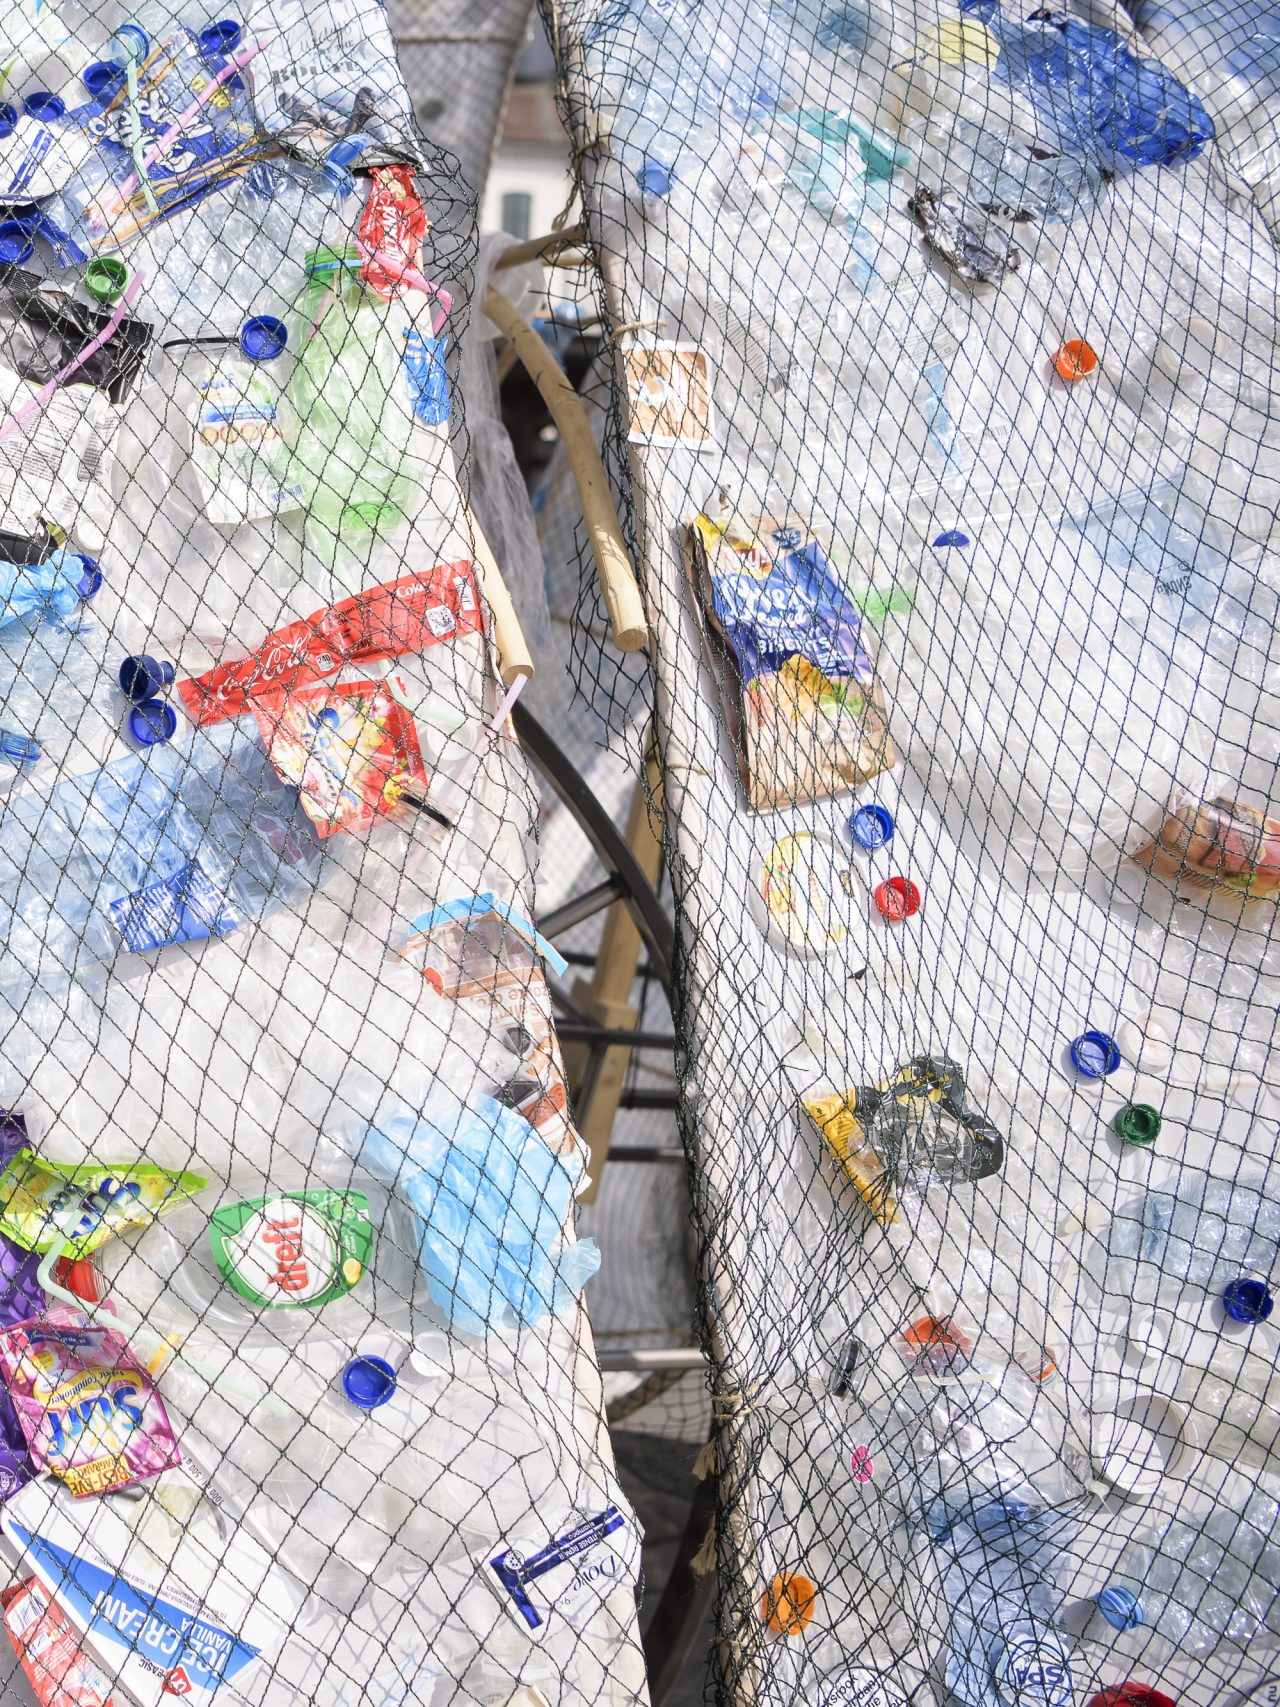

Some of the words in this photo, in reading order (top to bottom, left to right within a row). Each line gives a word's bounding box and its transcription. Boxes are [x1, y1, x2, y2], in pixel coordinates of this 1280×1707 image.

[378, 203, 402, 264] ULTANA
[261, 1216, 309, 1291] dreft
[46, 1385, 144, 1458] Surf
[188, 1464, 202, 1478] 500
[209, 1488, 225, 1506] 1000
[573, 1554, 617, 1592] Dove
[89, 1590, 181, 1655] CREAM
[1015, 1664, 1066, 1687] SPA
